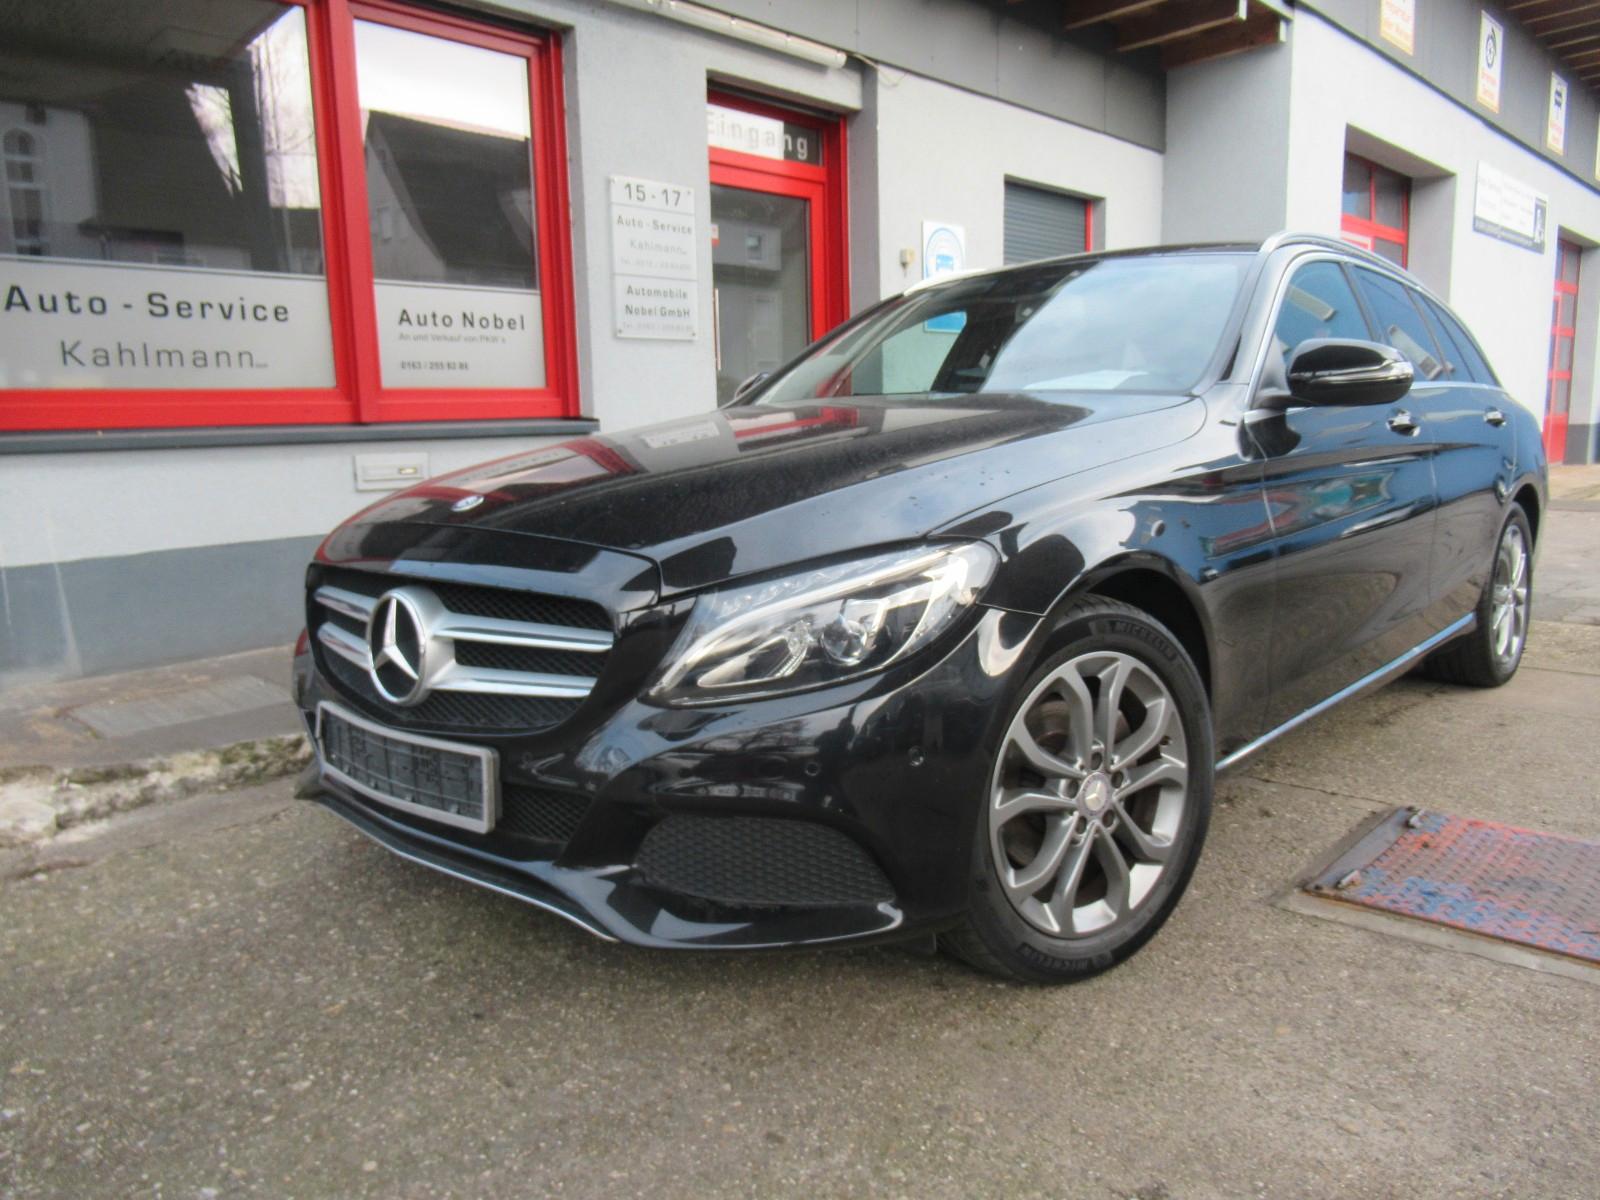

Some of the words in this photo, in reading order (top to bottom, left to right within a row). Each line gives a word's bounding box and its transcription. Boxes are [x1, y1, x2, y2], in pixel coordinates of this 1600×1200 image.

[624, 183, 646, 202] 15
[661, 189, 681, 207] 17
[617, 215, 643, 227] Auto
[652, 220, 692, 234] Service
[4, 285, 107, 315] Auto
[147, 292, 289, 322] Service
[626, 285, 688, 300] Automobile
[398, 308, 453, 328] Auto
[462, 311, 526, 331] Nobel
[625, 304, 657, 317] Nobel
[659, 306, 690, 319] GmbH
[60, 340, 255, 369] Kahlmann
